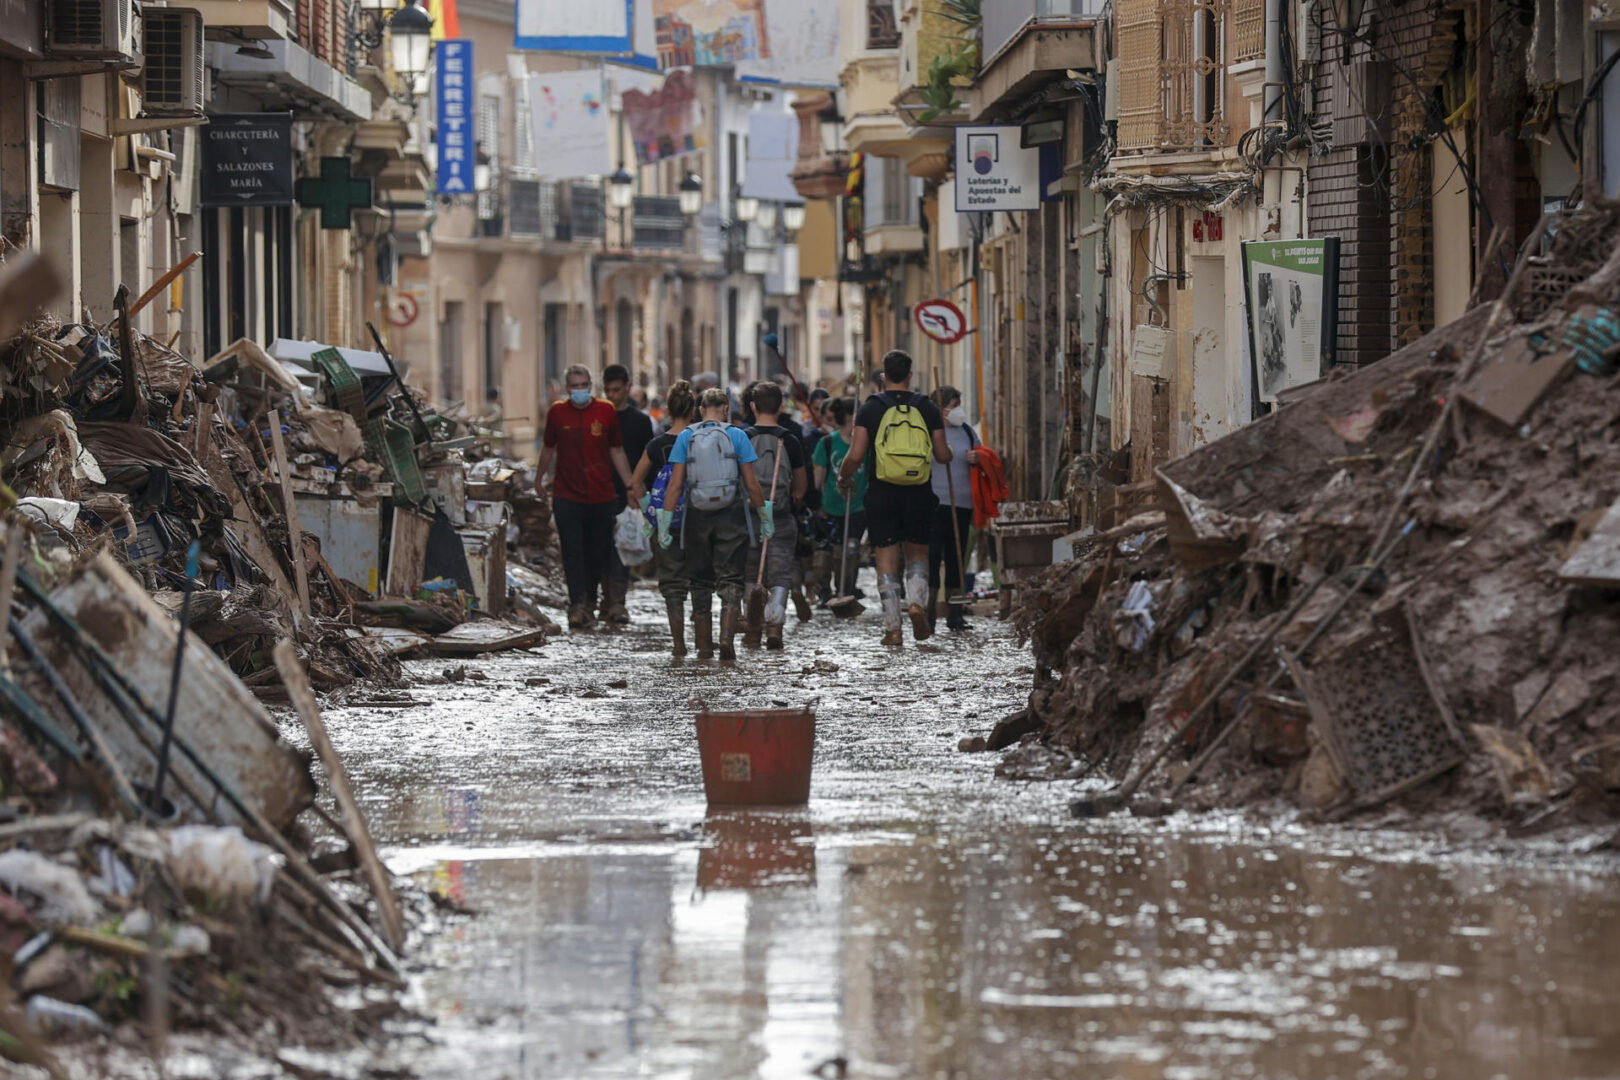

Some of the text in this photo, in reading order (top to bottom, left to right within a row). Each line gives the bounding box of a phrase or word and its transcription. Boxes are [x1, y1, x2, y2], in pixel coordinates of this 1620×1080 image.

[444, 43, 466, 191] FERRETERIA
[210, 129, 279, 140] CHARCUTERÍA
[241, 146, 249, 155] Y
[217, 162, 275, 172] SALAZONES
[230, 177, 263, 188] MARÍA
[1003, 178, 1009, 186] y
[968, 186, 1022, 196] Apuestas del
[968, 196, 997, 204] Estado
